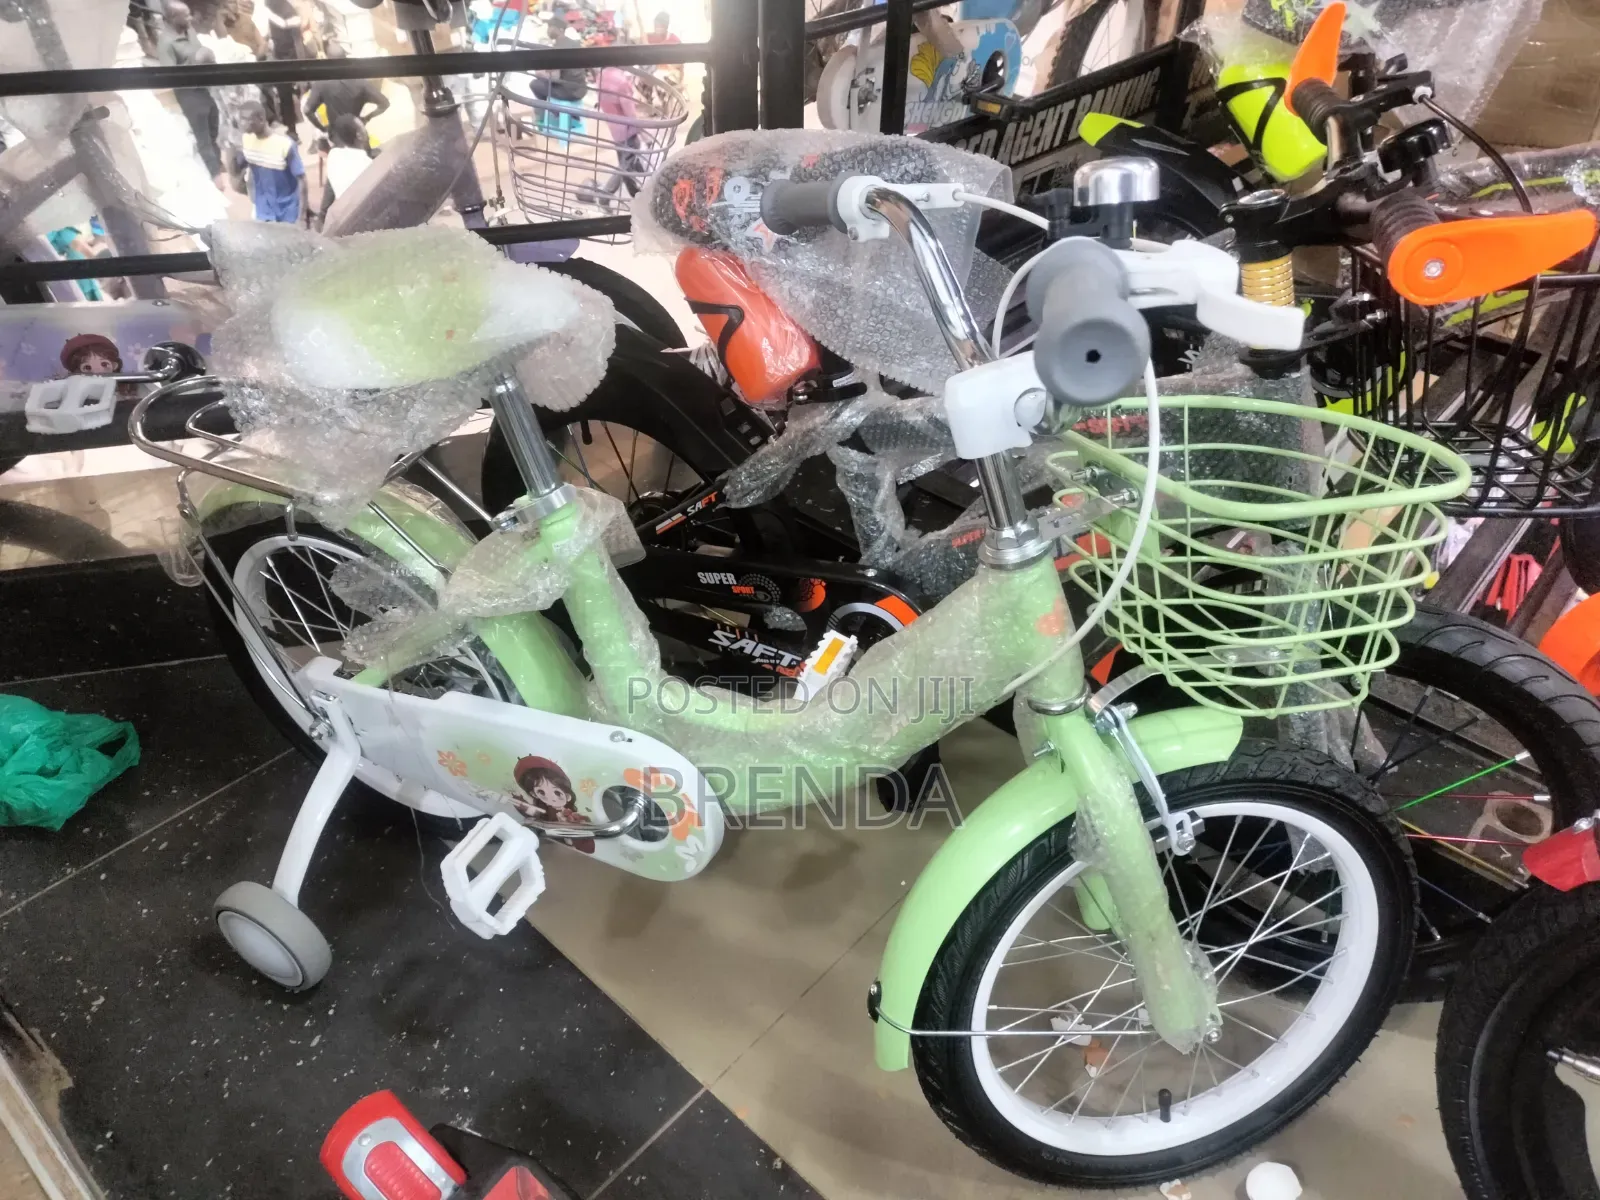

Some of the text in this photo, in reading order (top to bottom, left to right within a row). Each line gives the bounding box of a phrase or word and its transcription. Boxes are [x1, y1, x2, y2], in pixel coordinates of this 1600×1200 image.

[999, 99, 1076, 165] AGENT
[686, 491, 718, 516] SAFT
[697, 571, 737, 585] SUPER
[731, 585, 755, 594] SPORT
[708, 629, 802, 667] SAFT
